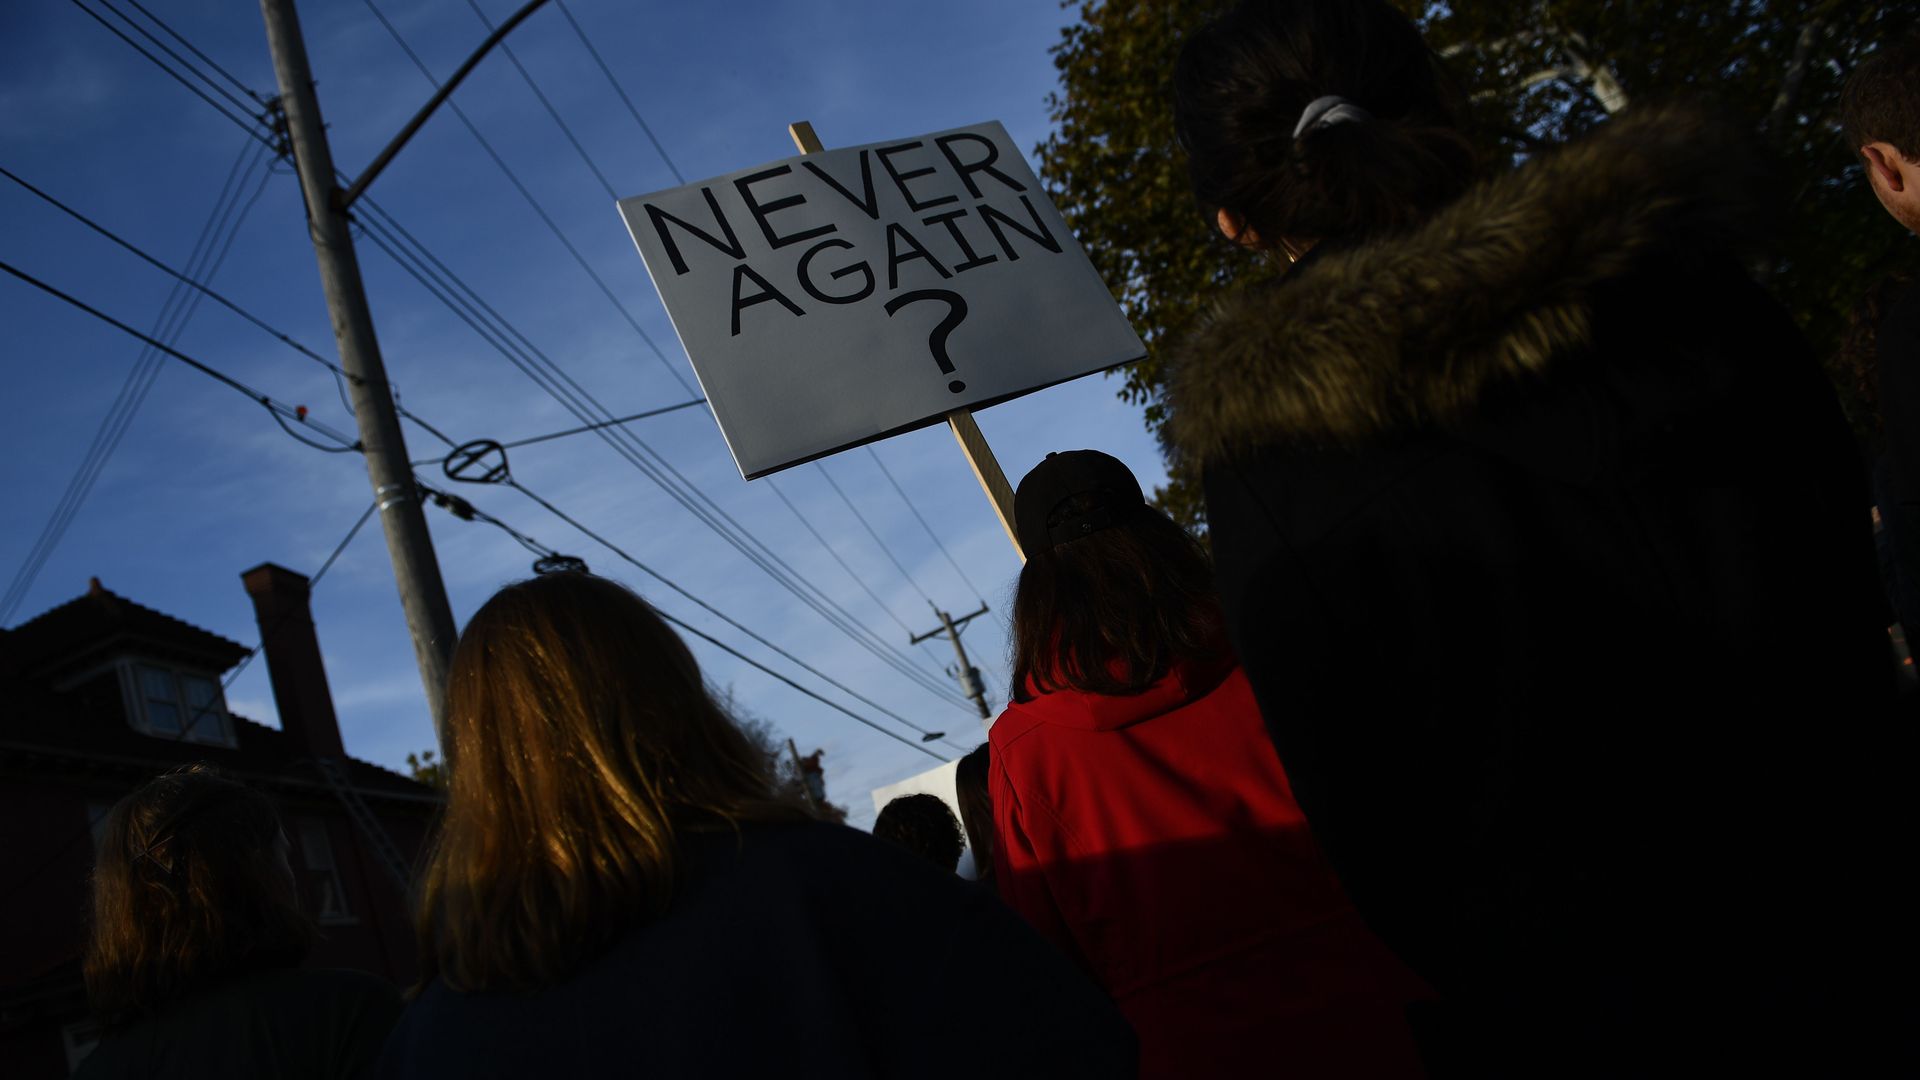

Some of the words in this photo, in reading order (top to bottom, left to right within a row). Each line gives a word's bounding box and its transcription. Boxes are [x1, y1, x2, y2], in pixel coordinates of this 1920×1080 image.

[643, 133, 1027, 275] NEVER
[731, 195, 1063, 337] AGAIN
[884, 289, 968, 394] ?
